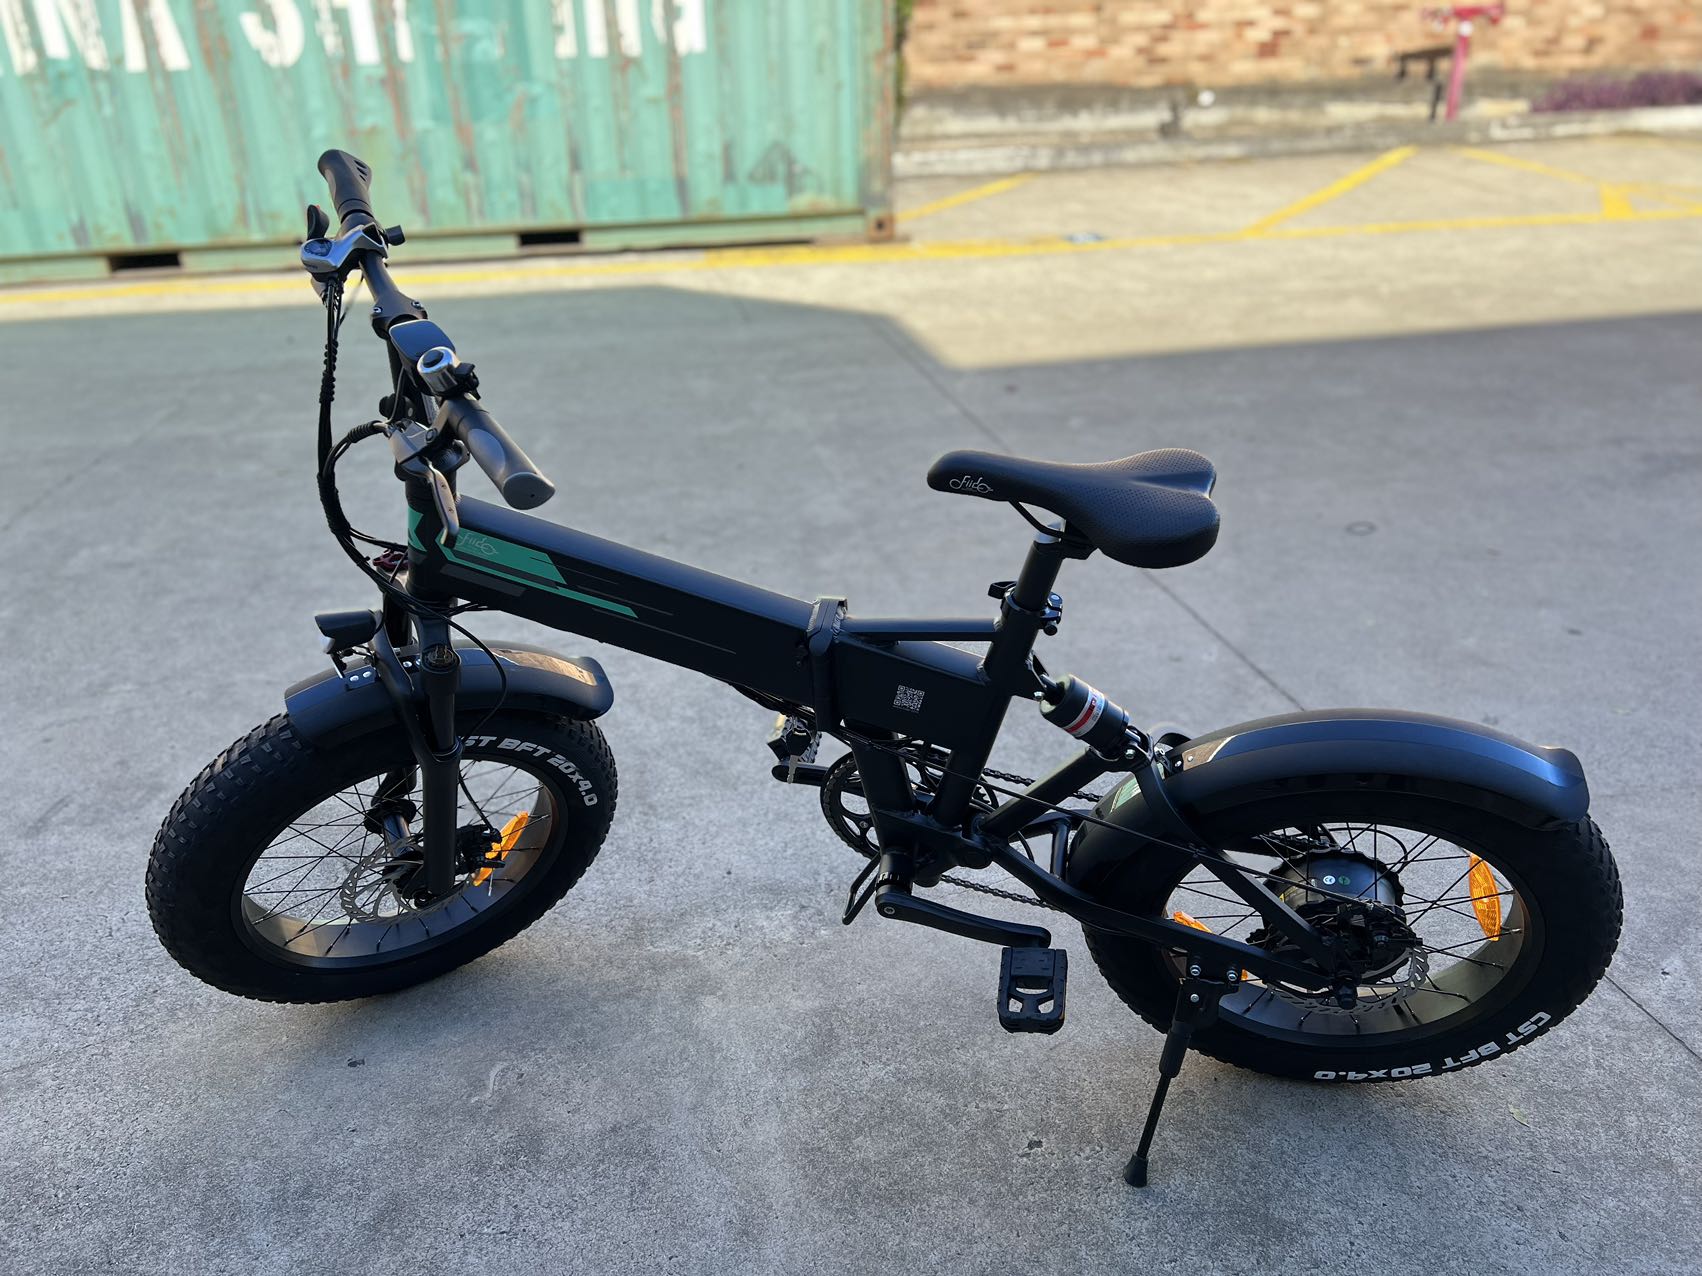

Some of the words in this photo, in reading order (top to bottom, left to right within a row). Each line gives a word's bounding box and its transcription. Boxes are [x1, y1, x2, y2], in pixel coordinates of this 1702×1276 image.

[458, 735, 498, 747] ST
[497, 738, 552, 757] BFT
[1505, 1011, 1552, 1045] CST
[1441, 1041, 1502, 1069] BFT
